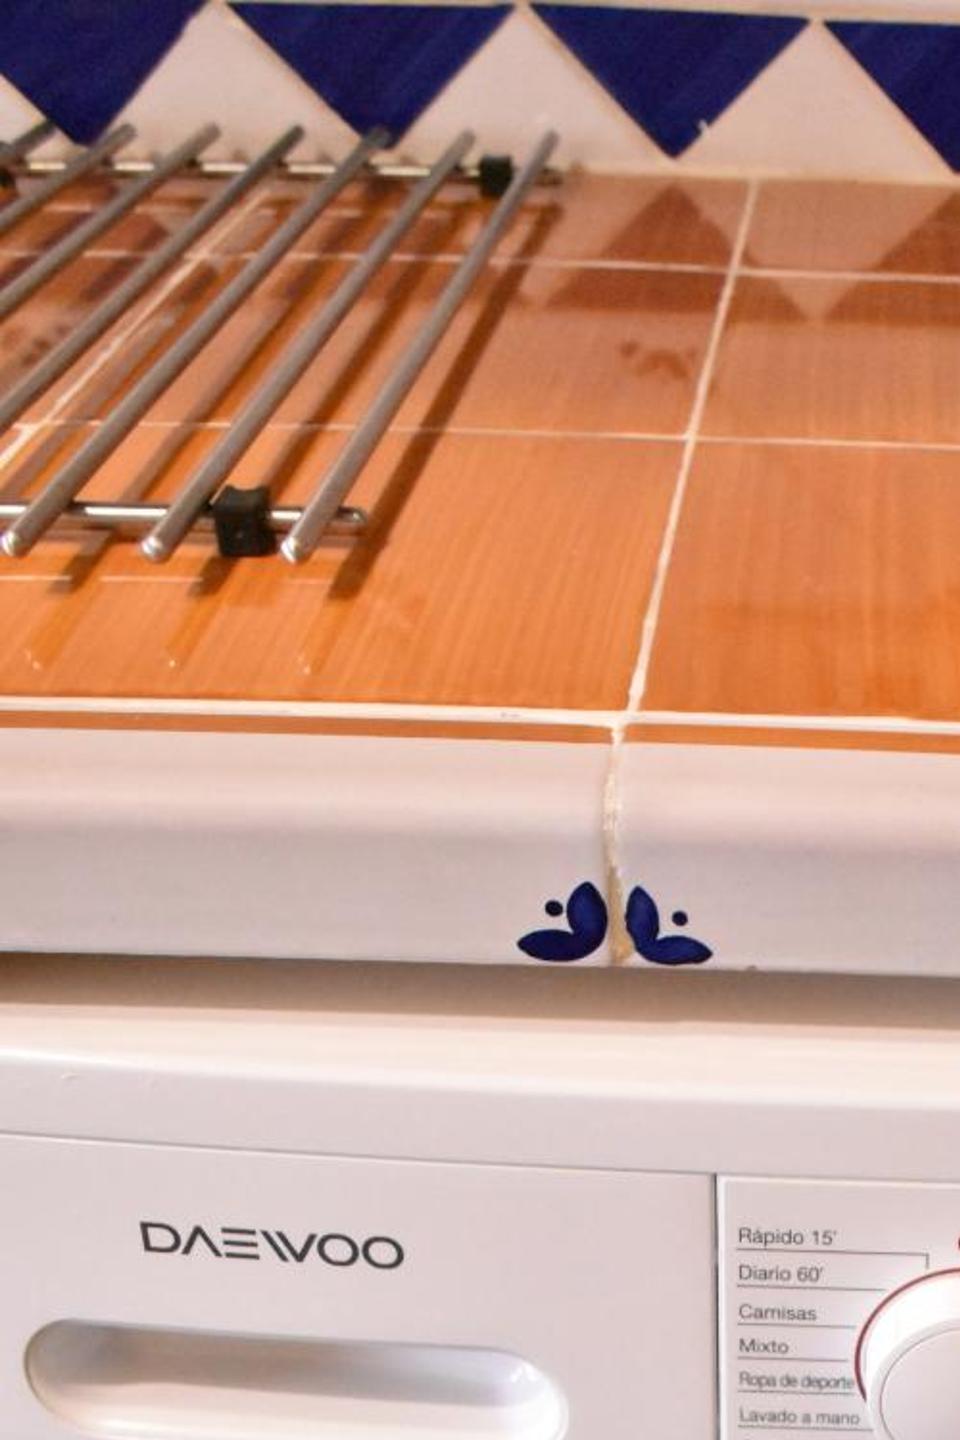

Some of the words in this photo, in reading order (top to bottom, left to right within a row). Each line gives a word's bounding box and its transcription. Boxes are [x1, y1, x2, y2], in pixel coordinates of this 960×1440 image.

[139, 1220, 405, 1270] DAEWOO
[737, 1226, 805, 1249] Rápido
[737, 1263, 792, 1283] Diario
[738, 1302, 818, 1322] Camisas
[738, 1336, 790, 1355] Mixto
[738, 1369, 778, 1390] Ropa
[778, 1372, 799, 1389] de
[800, 1374, 855, 1391] deporte
[738, 1405, 798, 1424] Lavado
[801, 1410, 813, 1425] a
[815, 1410, 861, 1426] mano
